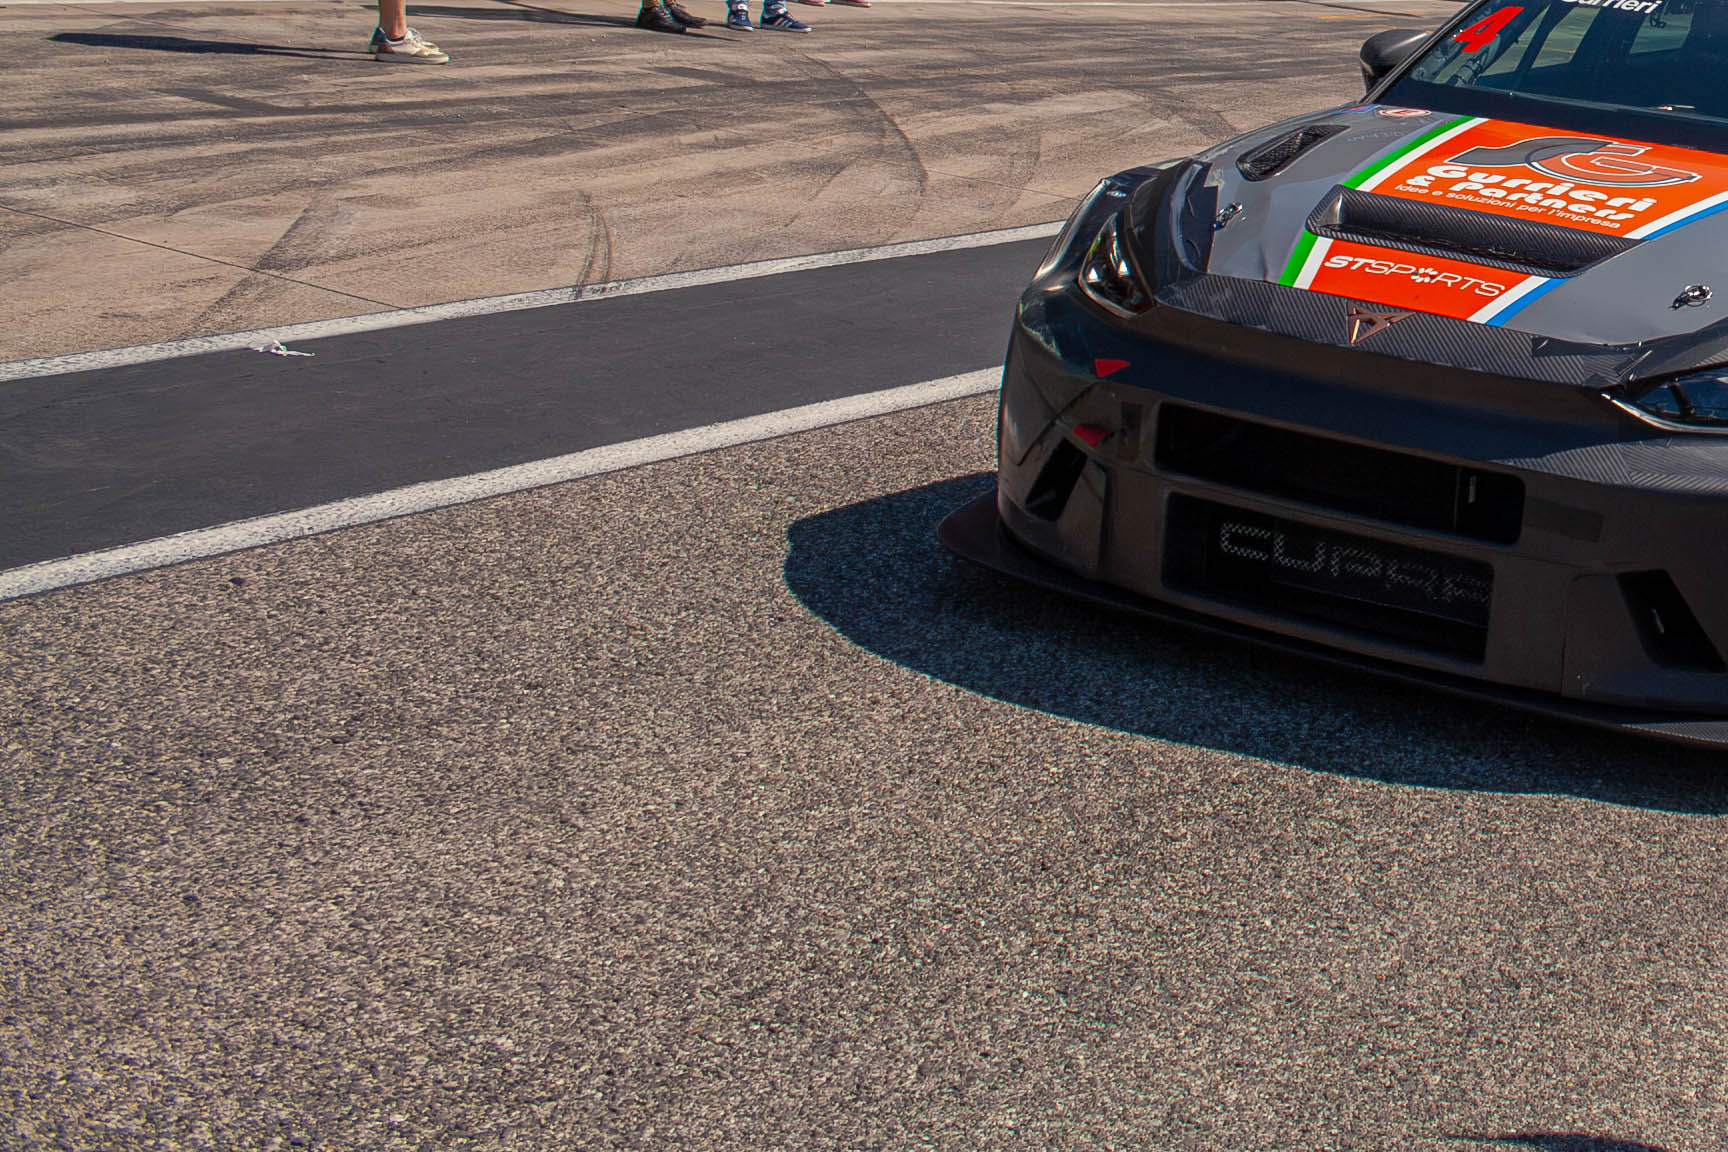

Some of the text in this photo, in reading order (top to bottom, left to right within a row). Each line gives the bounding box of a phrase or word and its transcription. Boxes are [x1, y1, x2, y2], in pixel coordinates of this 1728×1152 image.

[1452, 6, 1525, 54] 4
[1406, 176, 1635, 221] & Partners
[1426, 165, 1657, 212] Gurrieri
[1445, 191, 1515, 209] soluzioni
[1517, 203, 1545, 215] per
